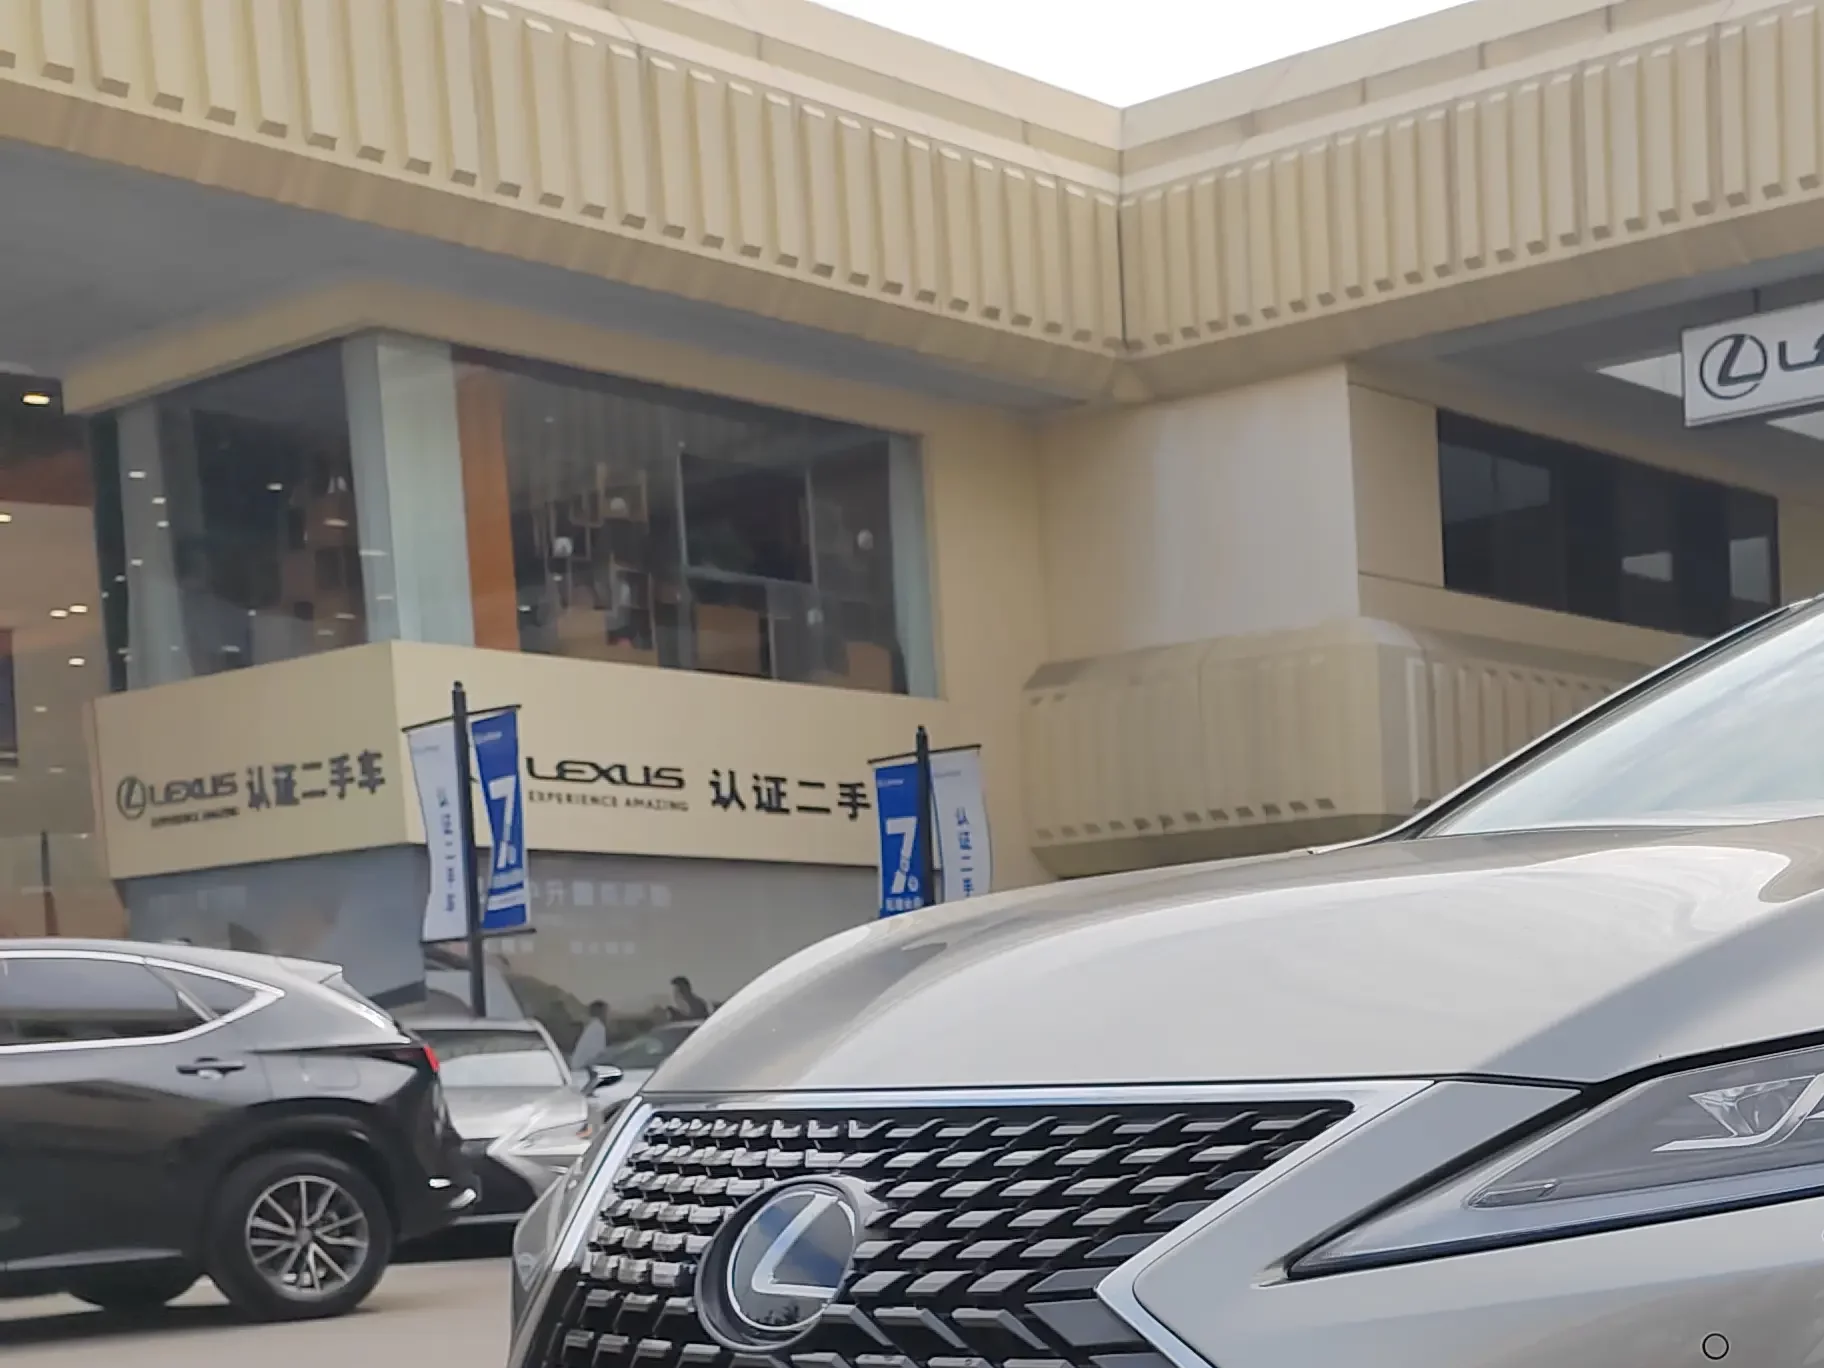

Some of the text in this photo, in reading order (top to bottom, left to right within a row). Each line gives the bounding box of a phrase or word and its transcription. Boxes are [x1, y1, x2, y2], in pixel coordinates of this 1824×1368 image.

[150, 750, 386, 811] LEXUS 认证二手车
[525, 757, 685, 789] LEXUS
[528, 789, 689, 812] EXPERIENCE AMAZING
